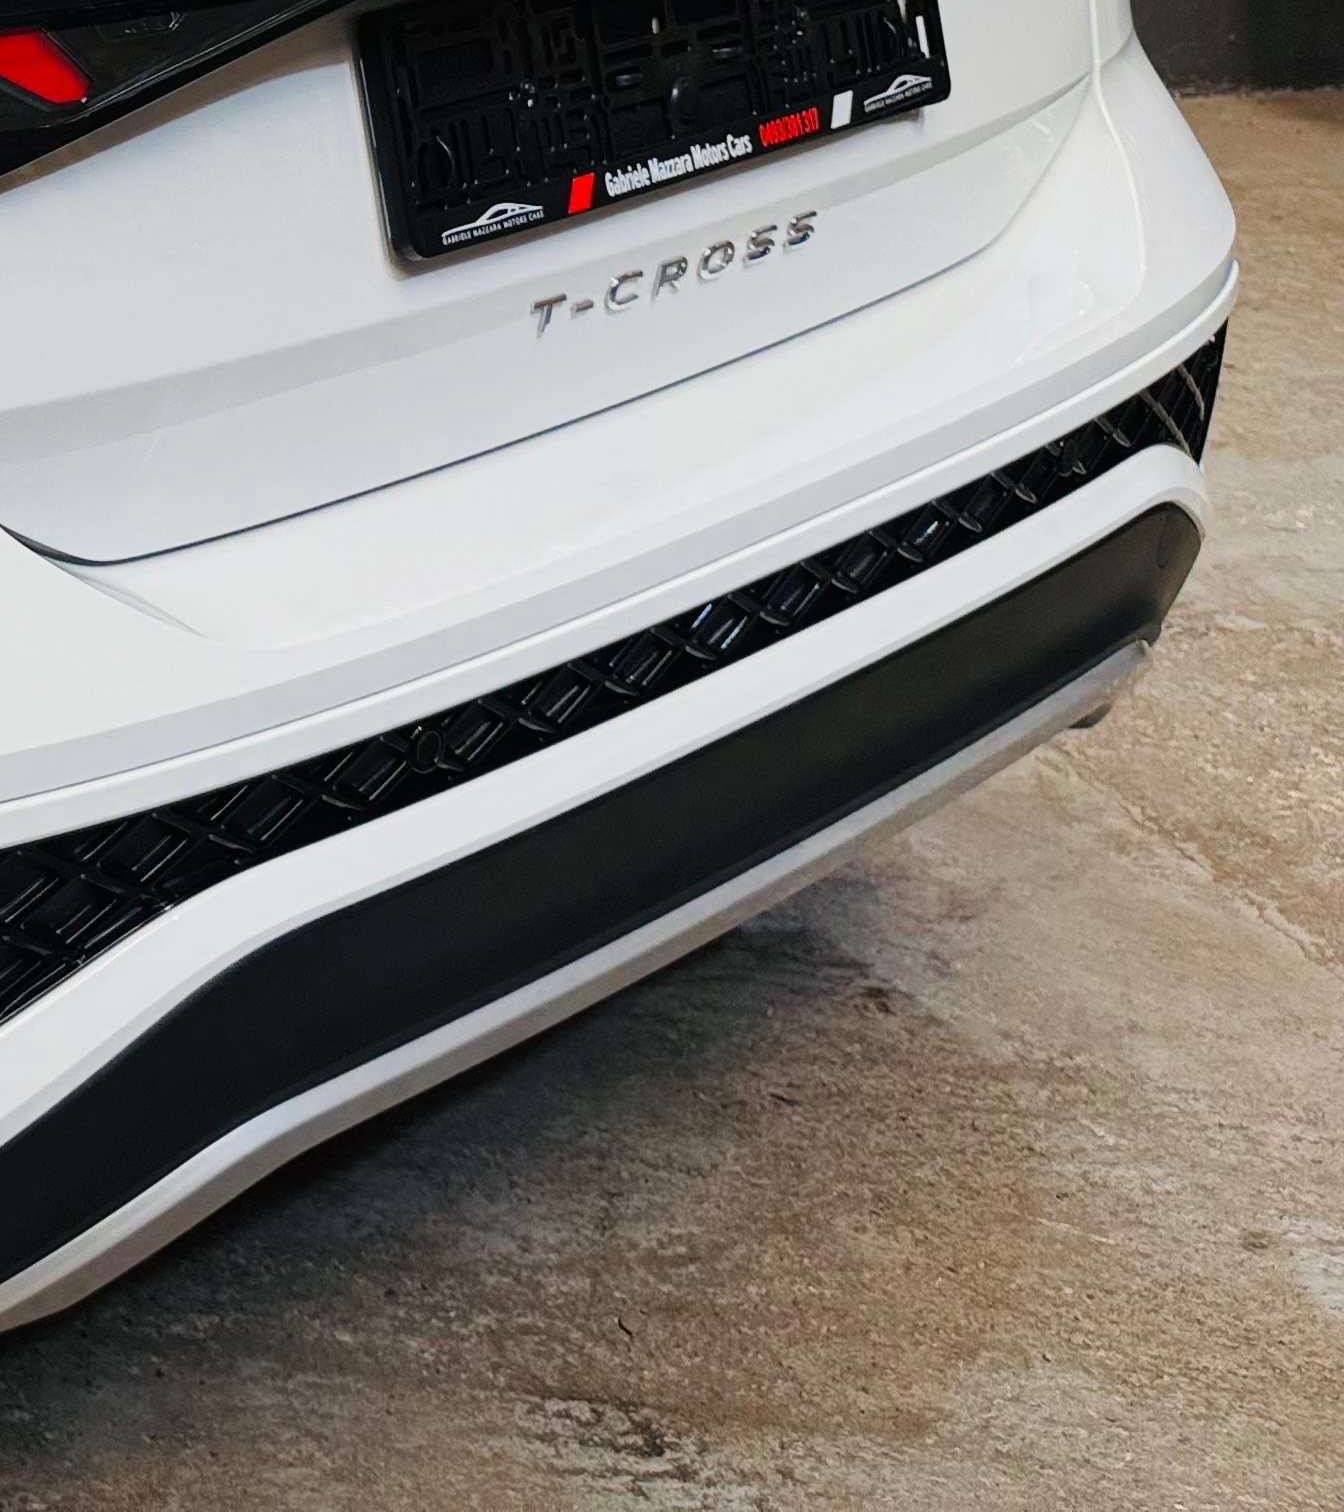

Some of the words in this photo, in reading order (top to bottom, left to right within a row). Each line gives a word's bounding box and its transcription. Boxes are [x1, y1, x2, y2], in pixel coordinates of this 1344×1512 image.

[604, 162, 650, 197] Gabriele
[648, 151, 694, 184] Mazzara
[690, 140, 730, 170] Motors
[726, 133, 754, 158] Cars
[530, 208, 819, 339] T-CROSS
